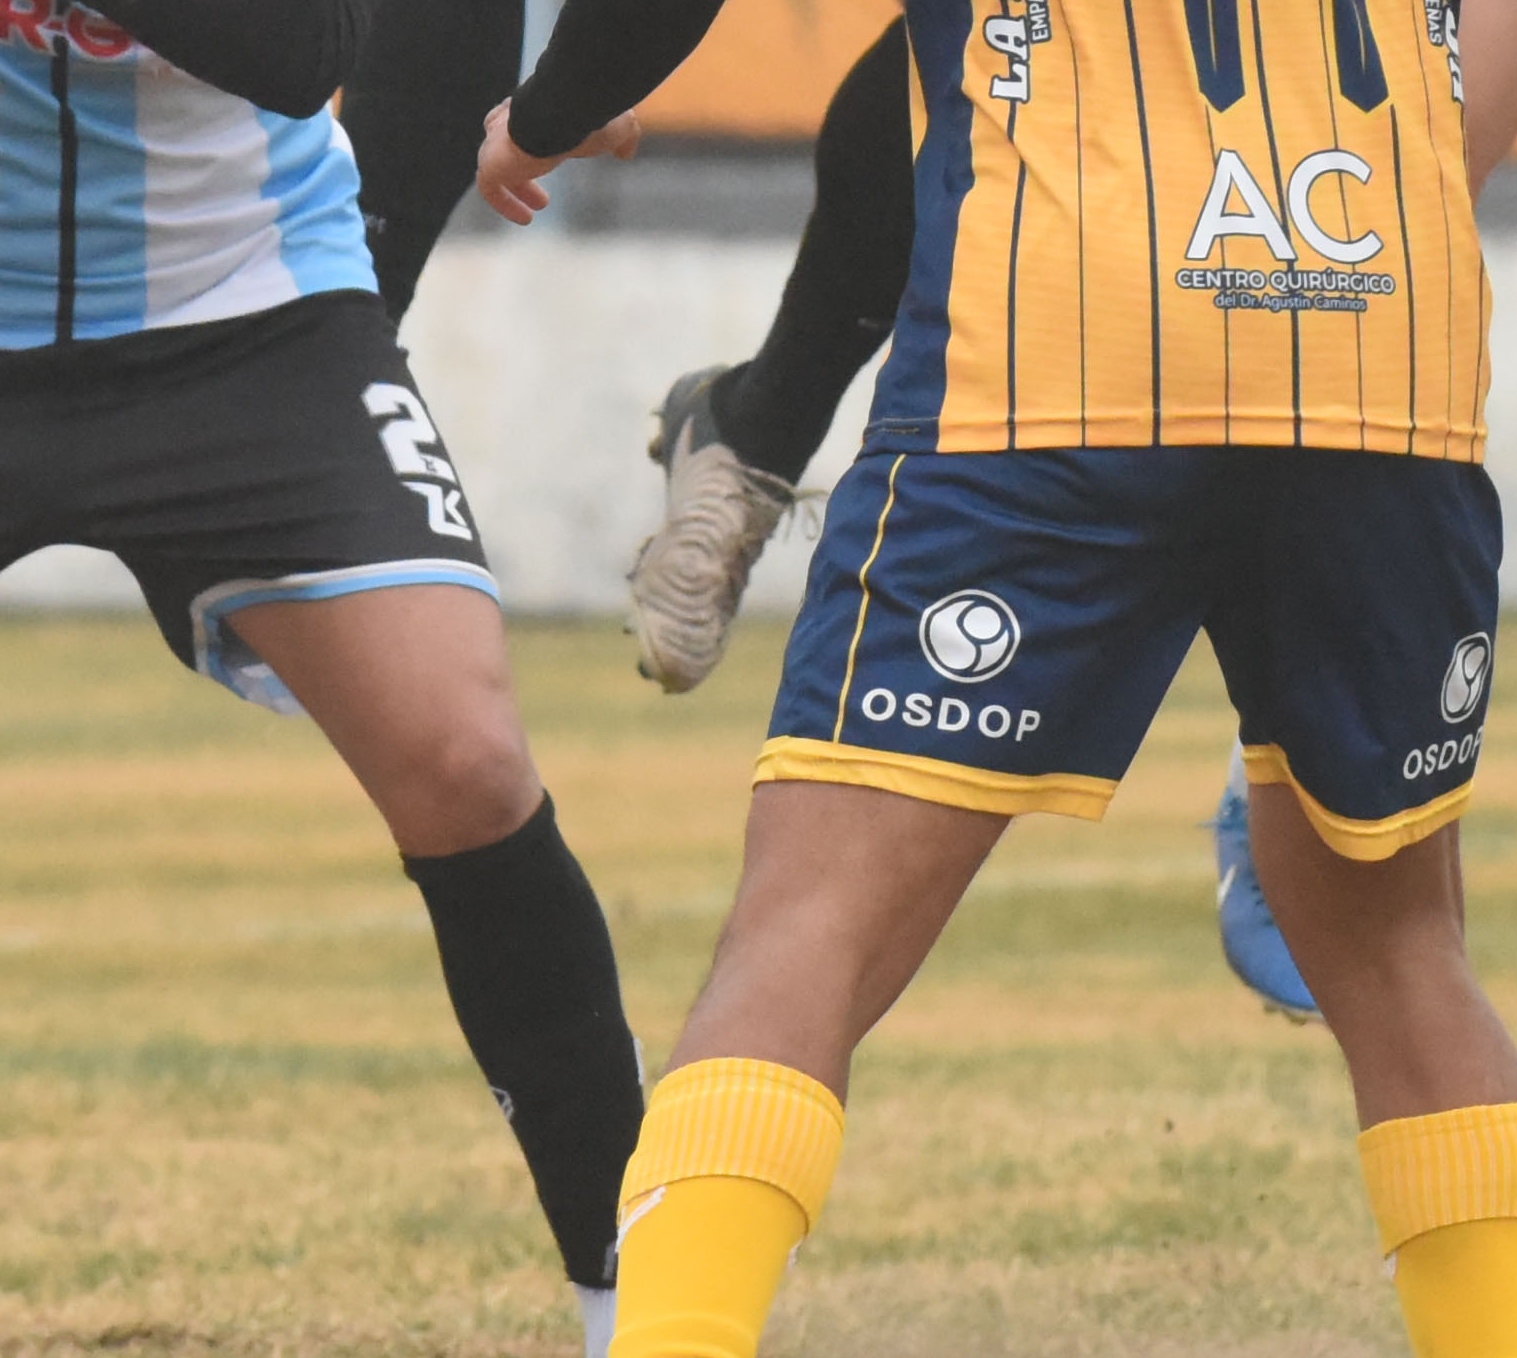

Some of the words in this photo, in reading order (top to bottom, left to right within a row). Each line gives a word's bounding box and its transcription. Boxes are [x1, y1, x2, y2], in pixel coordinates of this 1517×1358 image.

[984, 16, 1029, 101] LA
[1185, 148, 1384, 264] AC
[1176, 270, 1266, 288] CENTRO
[1270, 267, 1396, 293] QUIRÚRGICO
[1214, 294, 1236, 308] del
[1240, 294, 1261, 308] Dr.
[1262, 293, 1311, 311] Agustín
[1313, 295, 1367, 311] Caminos
[360, 381, 458, 485] 2
[862, 687, 1041, 742] OSDOP
[1402, 725, 1483, 781] OSDOP
